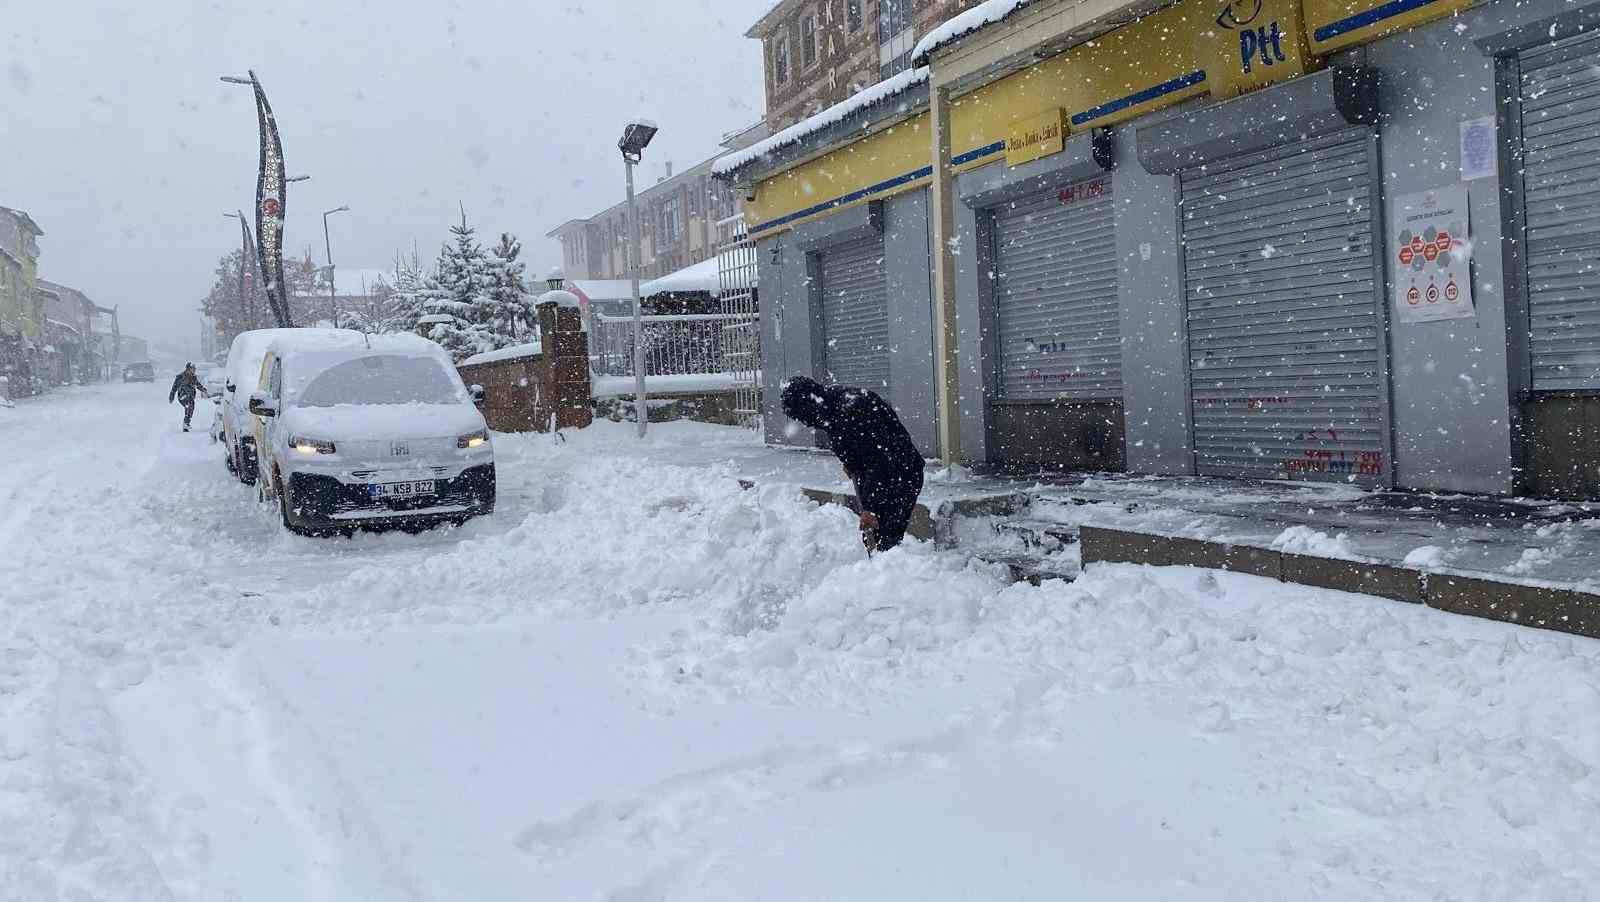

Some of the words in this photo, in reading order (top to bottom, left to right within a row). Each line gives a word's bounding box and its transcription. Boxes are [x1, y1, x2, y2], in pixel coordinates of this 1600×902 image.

[376, 485, 388, 496] 34
[393, 483, 412, 495] NSB
[414, 481, 433, 493] 822
